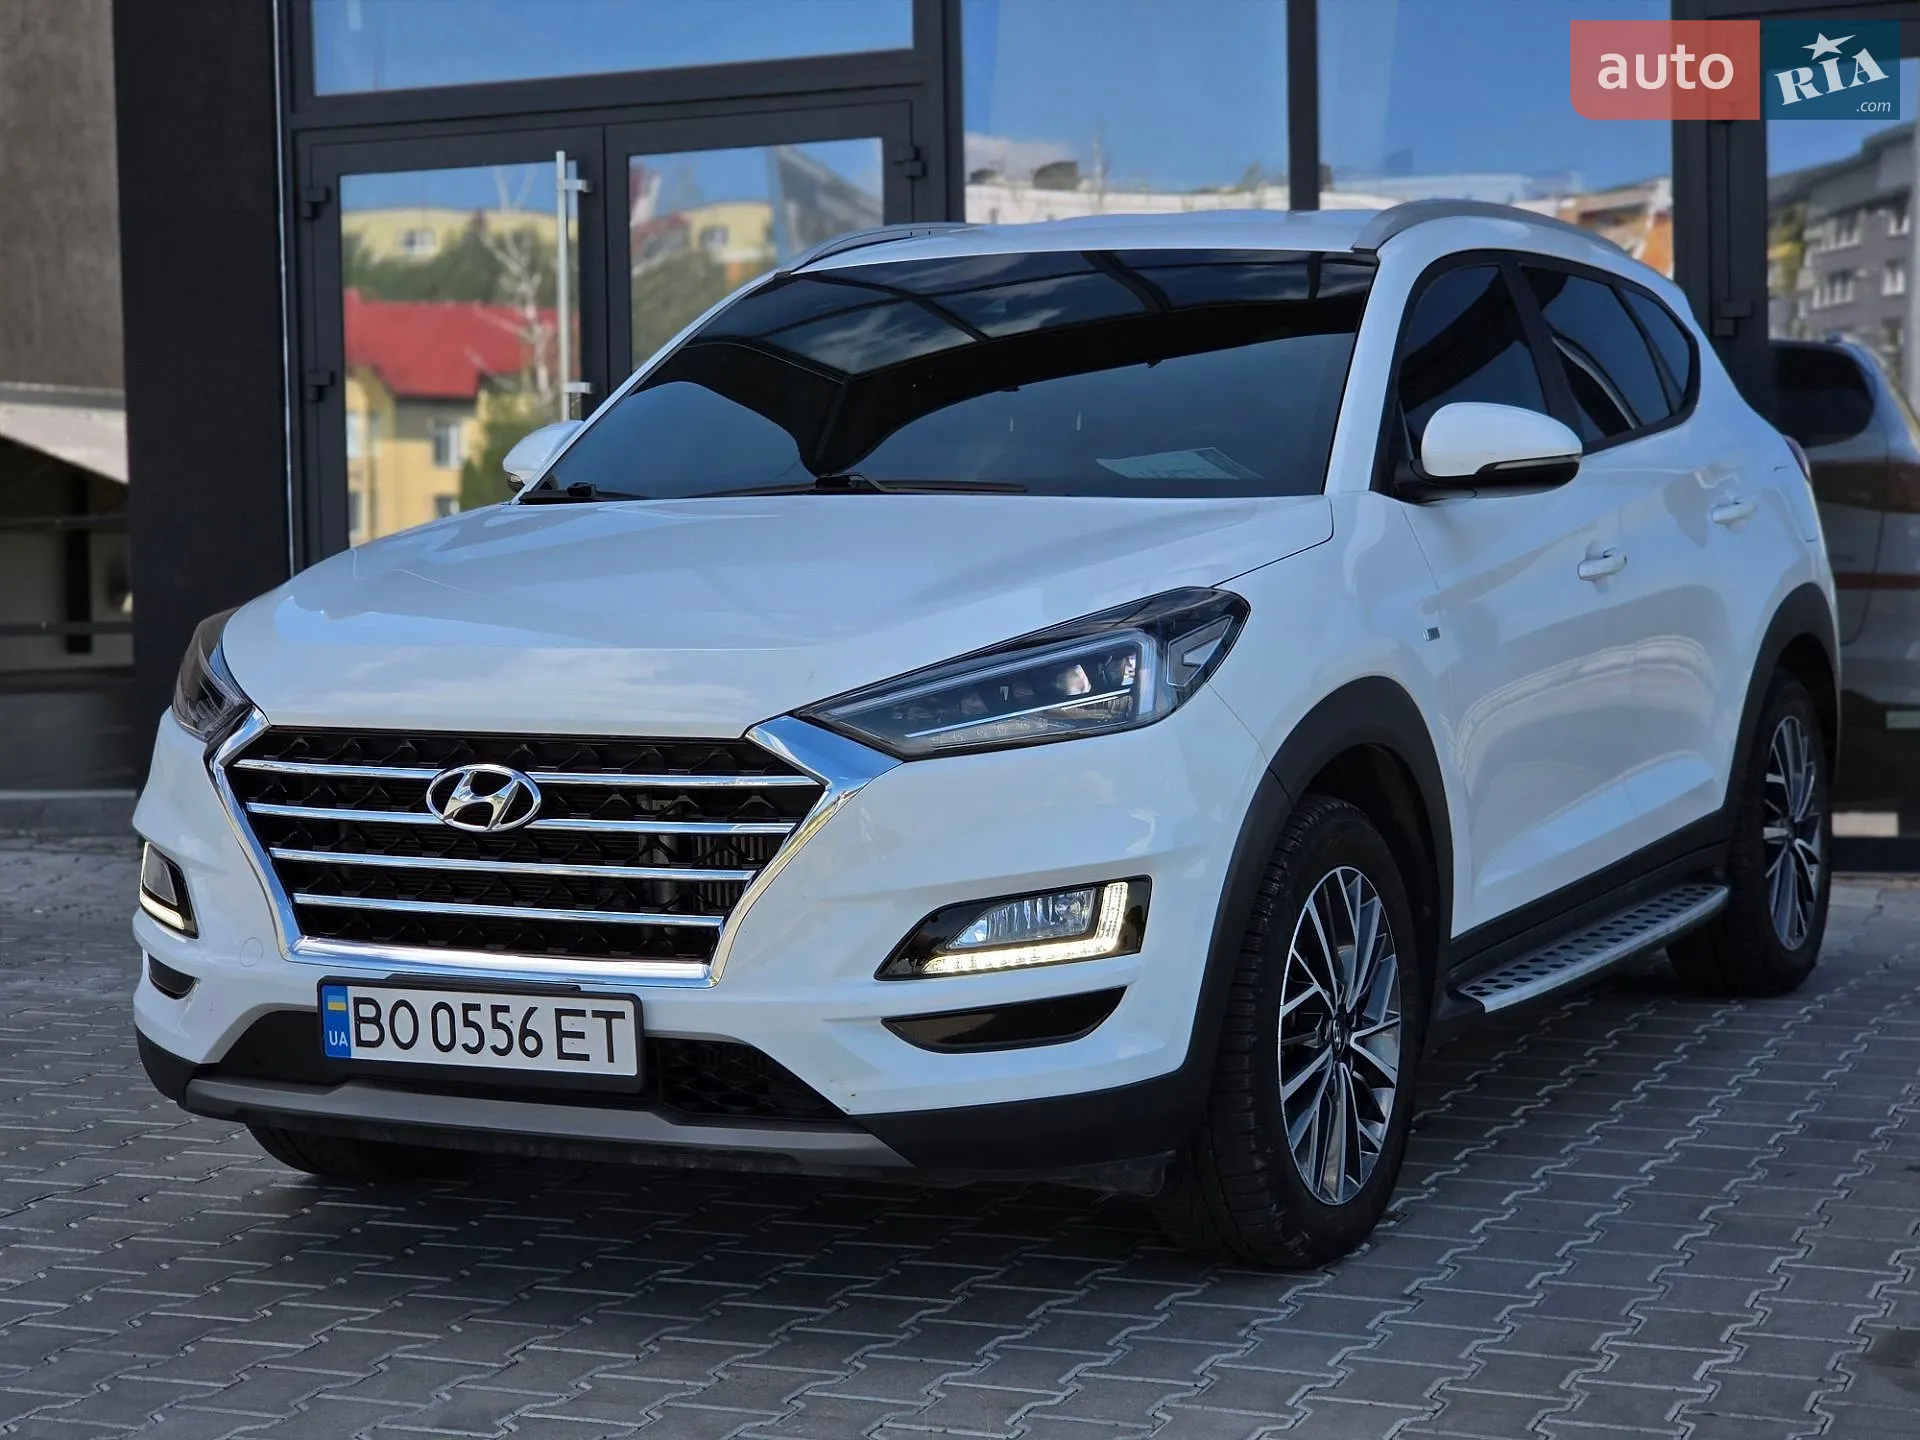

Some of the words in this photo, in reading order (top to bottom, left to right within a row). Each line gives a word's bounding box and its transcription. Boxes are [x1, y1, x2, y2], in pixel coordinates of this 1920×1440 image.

[328, 1030, 349, 1047] UA
[352, 996, 420, 1051] BO
[430, 1001, 544, 1059] 0556
[554, 1007, 626, 1064] ET
